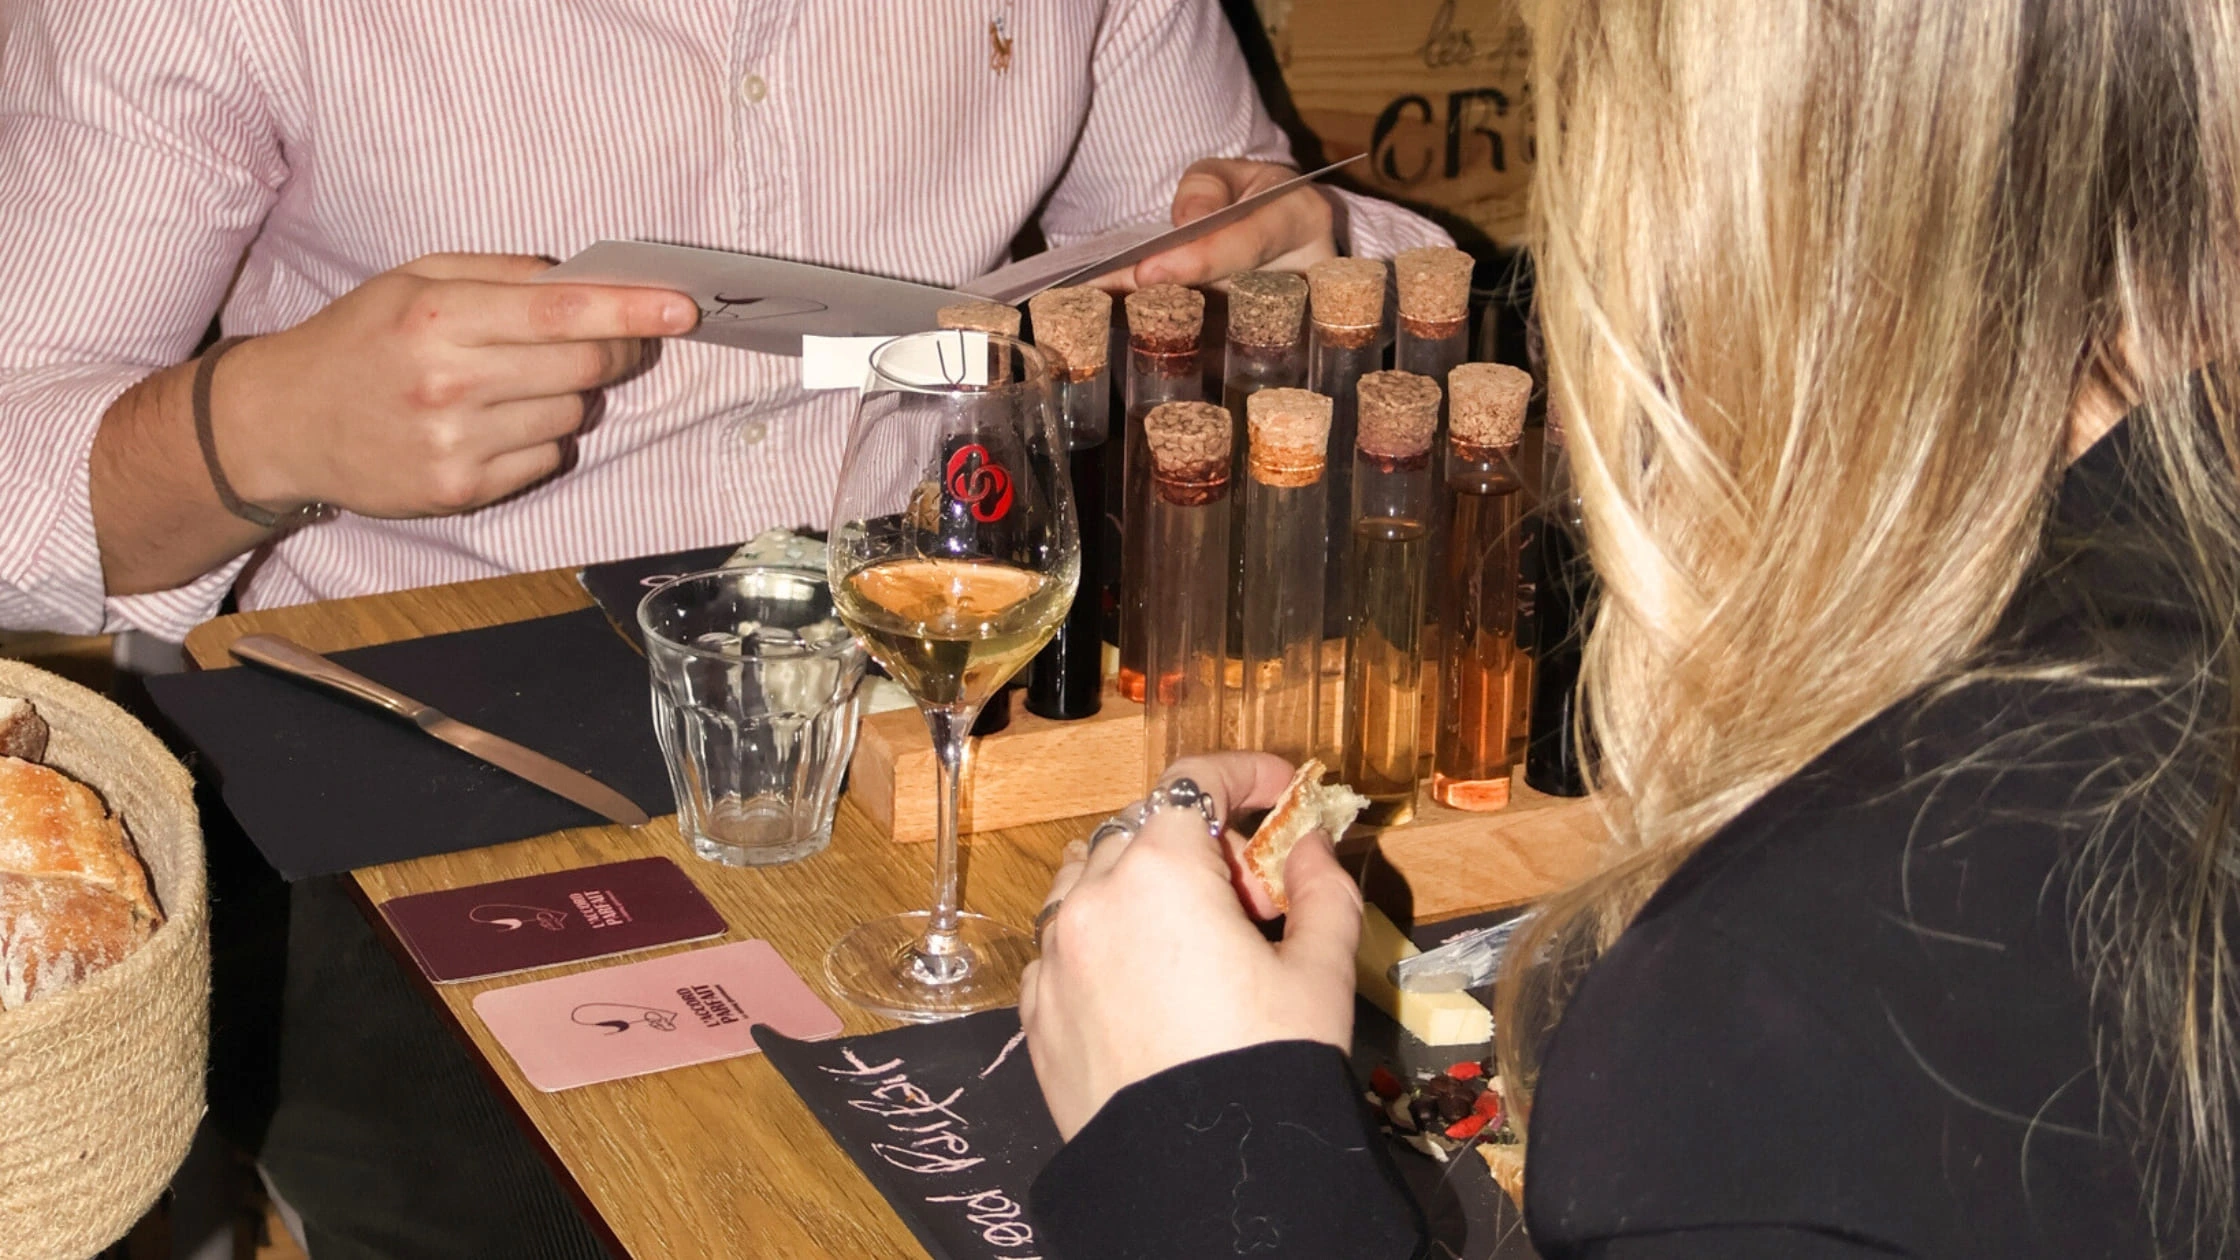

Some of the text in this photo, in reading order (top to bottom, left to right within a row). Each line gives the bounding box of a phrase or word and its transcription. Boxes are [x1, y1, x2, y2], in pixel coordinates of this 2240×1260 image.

[569, 892, 605, 929] L'ACCORD
[584, 890, 624, 926] PARFAIT
[676, 987, 720, 1028] L'ACCORD
[690, 985, 739, 1024] PARFAIT
